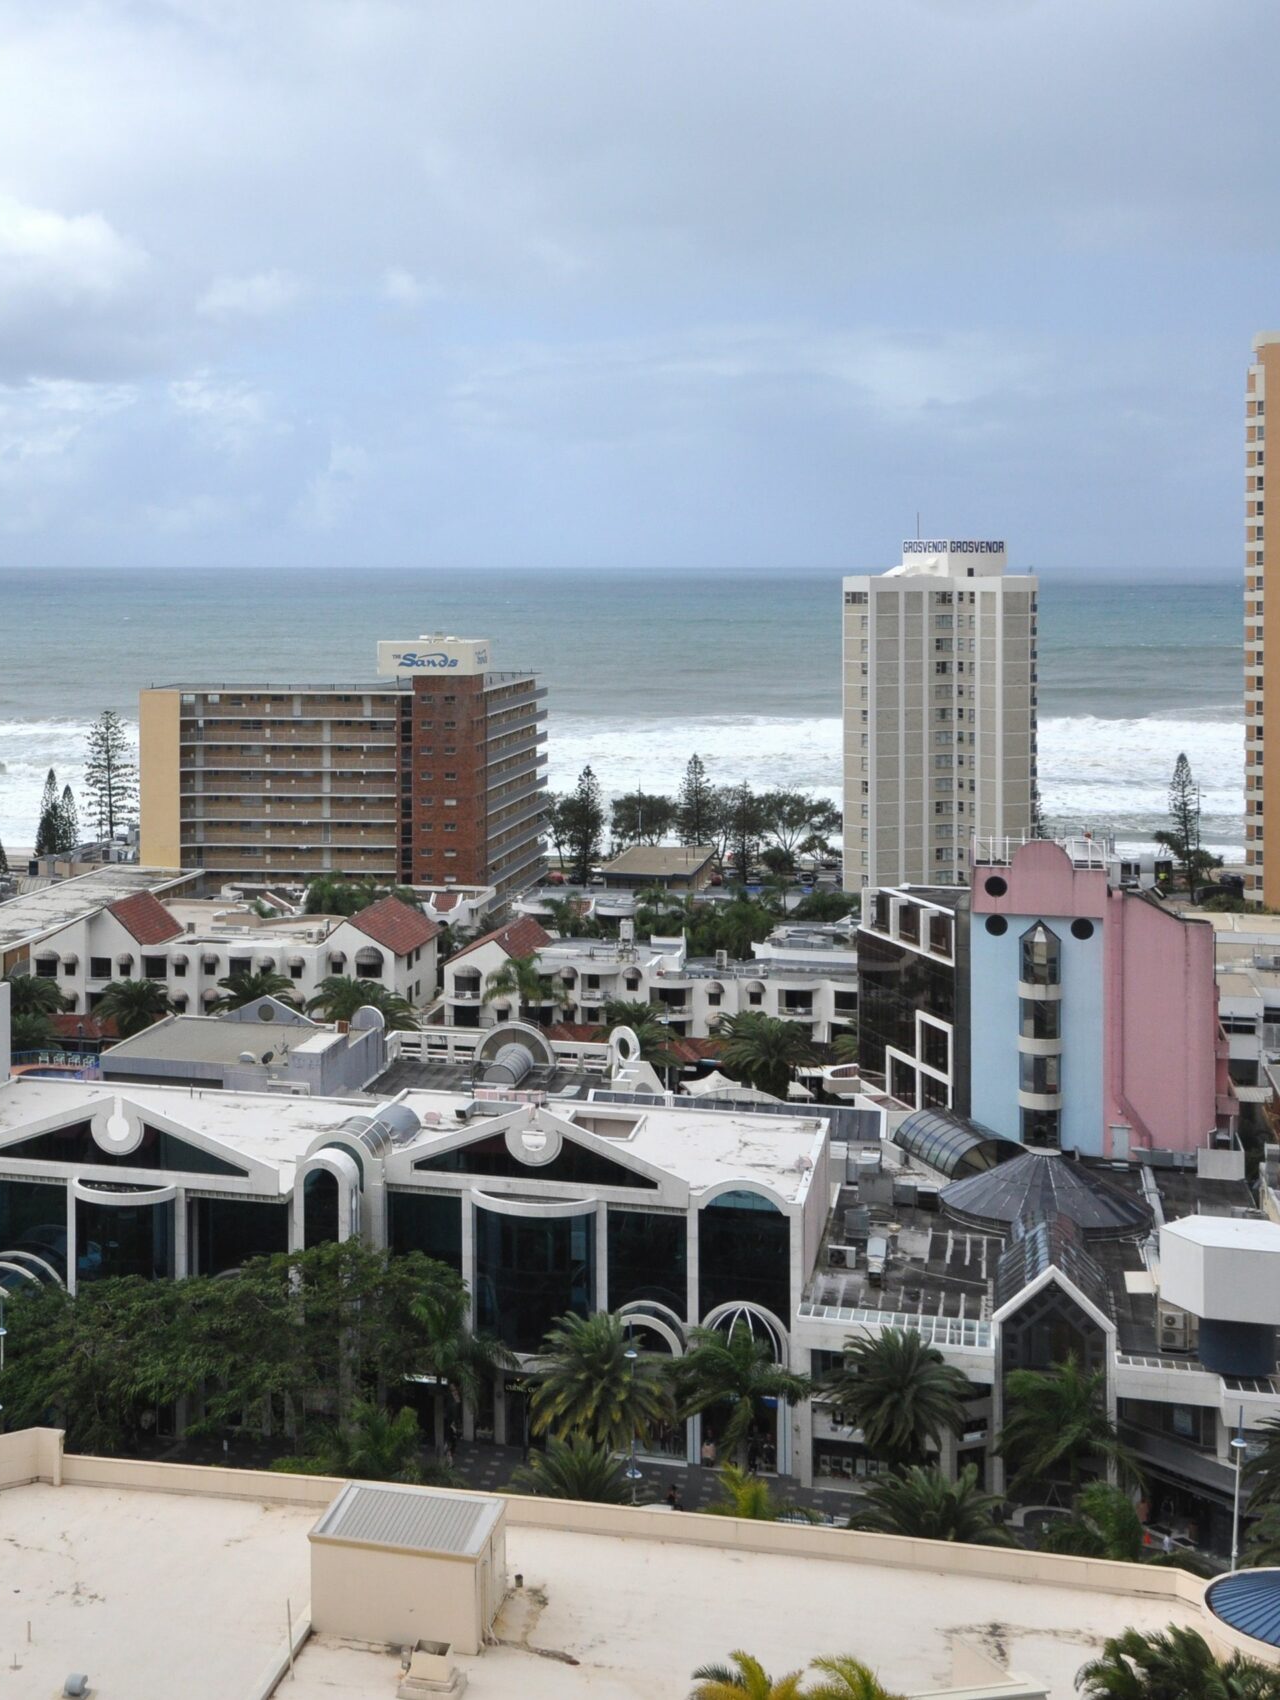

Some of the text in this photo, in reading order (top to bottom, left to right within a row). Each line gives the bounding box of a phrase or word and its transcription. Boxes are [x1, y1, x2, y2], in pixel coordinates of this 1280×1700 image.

[903, 541, 947, 554] GROSVENOR
[950, 541, 1005, 554] GROSVENOR
[398, 653, 459, 668] Sands
